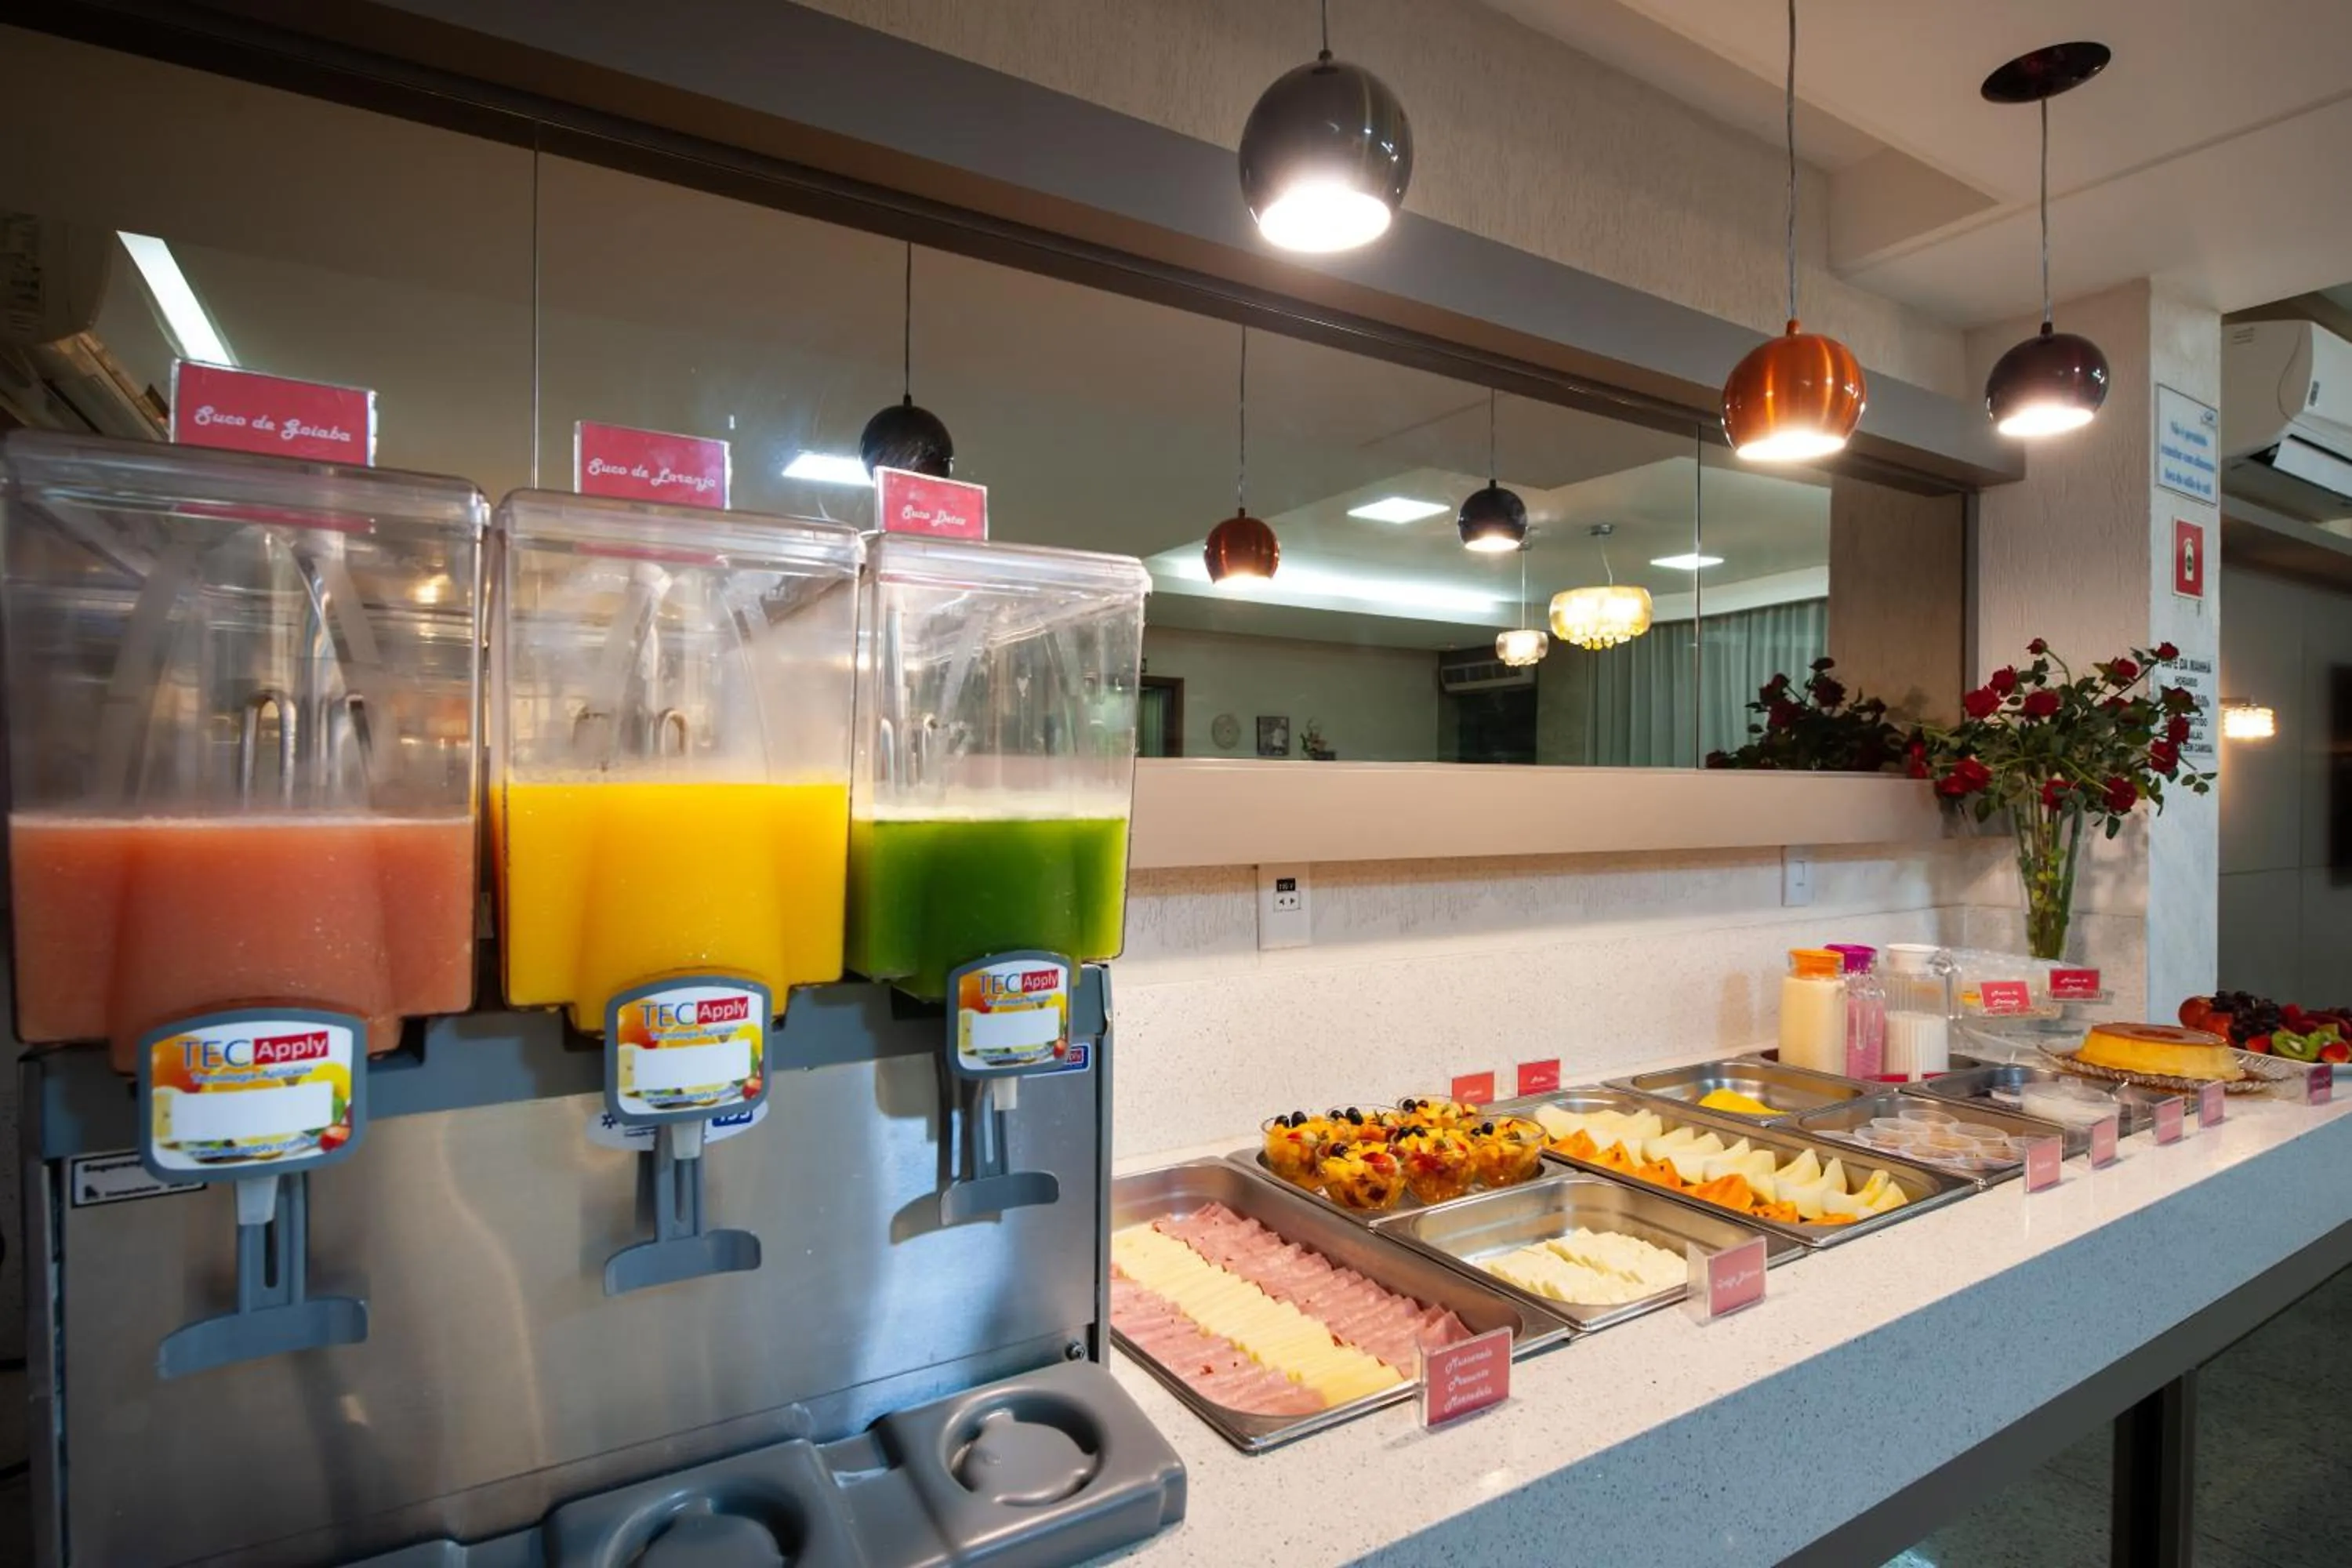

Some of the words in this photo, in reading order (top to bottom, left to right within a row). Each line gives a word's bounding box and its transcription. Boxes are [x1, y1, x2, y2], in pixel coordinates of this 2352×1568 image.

[194, 405, 246, 426] Suco
[252, 415, 275, 431] de
[281, 418, 351, 441] Goiaba
[588, 457, 627, 476] Suco
[631, 465, 649, 478] de
[650, 468, 716, 491] Laranja
[978, 973, 1019, 995] TEC
[1024, 971, 1058, 989] Apply
[641, 1002, 695, 1028] TEC
[699, 1000, 747, 1022] Apply
[176, 1040, 251, 1069] TEC
[256, 1036, 328, 1062] Apply
